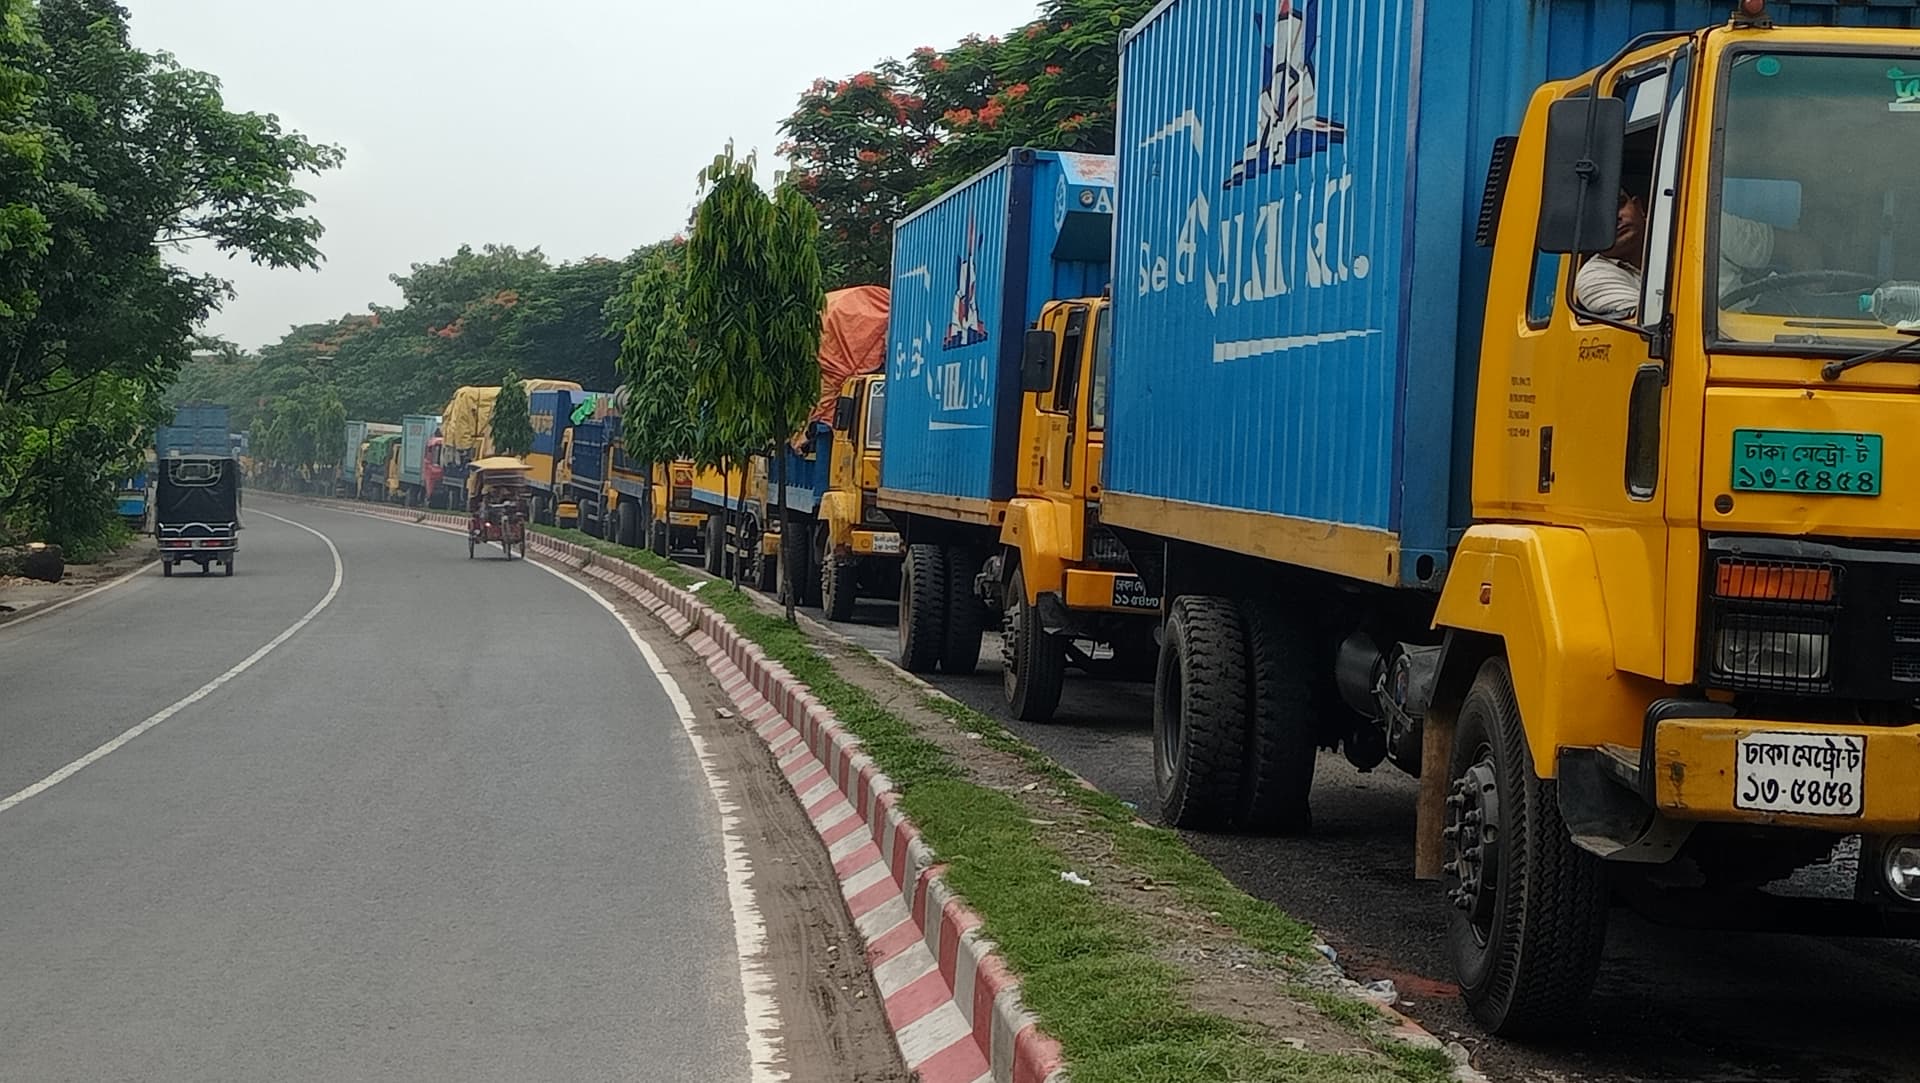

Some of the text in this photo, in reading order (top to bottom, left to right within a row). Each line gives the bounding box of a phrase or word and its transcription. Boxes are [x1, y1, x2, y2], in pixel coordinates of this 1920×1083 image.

[1744, 443, 1788, 460] ঢাকা
[1739, 466, 1873, 492] ১৩-৫৪৫৪
[1743, 743, 1790, 766] ঢাকা
